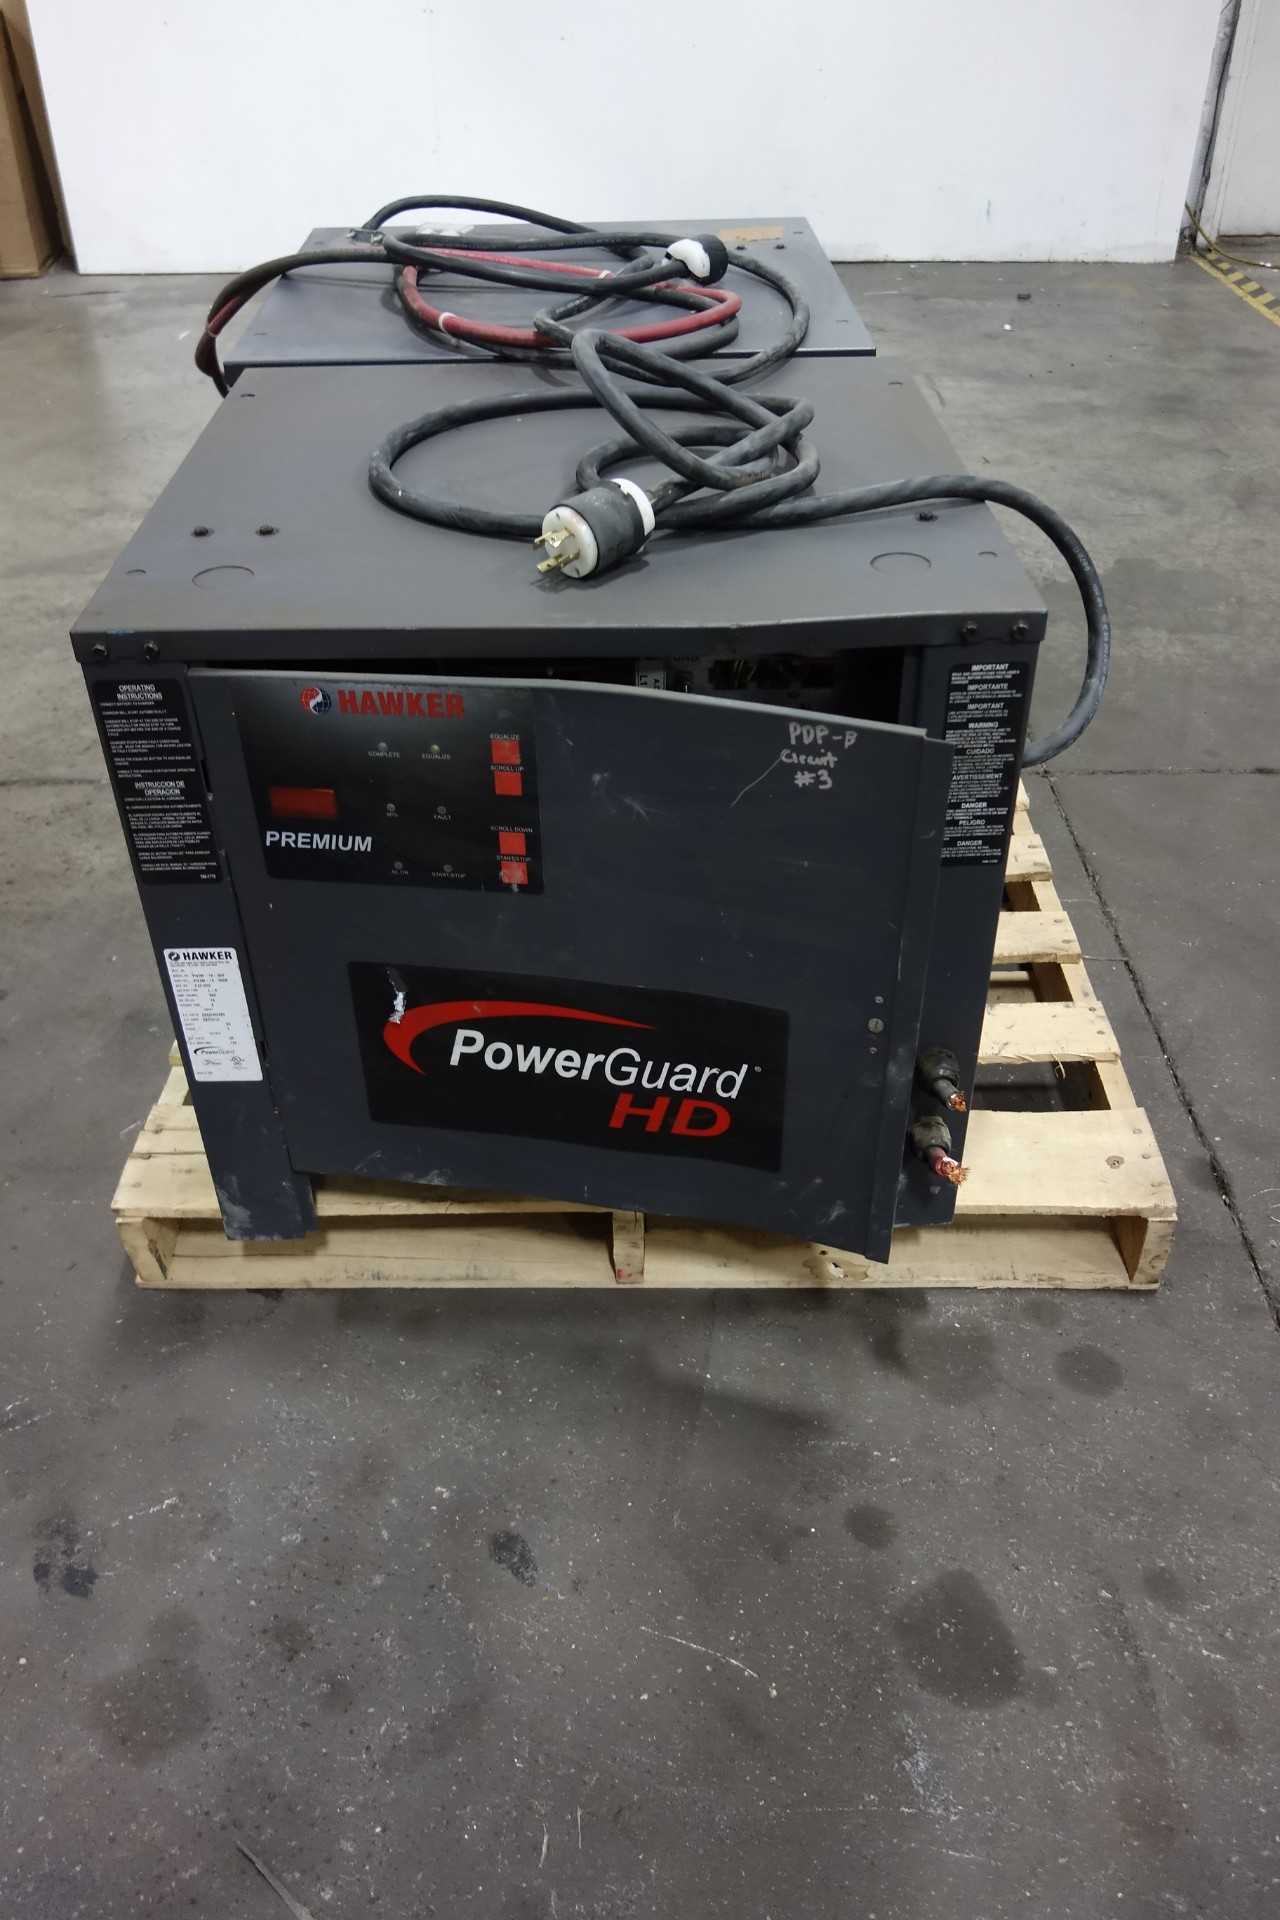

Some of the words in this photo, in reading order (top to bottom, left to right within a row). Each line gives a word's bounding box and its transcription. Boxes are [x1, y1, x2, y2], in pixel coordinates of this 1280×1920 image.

[970, 663, 1009, 671] IMPORTANT
[118, 683, 156, 692] OPERATING
[967, 683, 1009, 691] IMPORTANTE
[116, 692, 163, 701] INSTRUCTIONS
[337, 689, 465, 720] HAWKER
[966, 702, 1005, 710] IMPORTANT
[968, 721, 999, 729] WARNING
[794, 770, 833, 790] #3
[265, 830, 373, 852] PREMIUM
[182, 951, 233, 961] HAWKER
[449, 1028, 749, 1100] PowerGuard
[608, 1092, 732, 1138] HD
